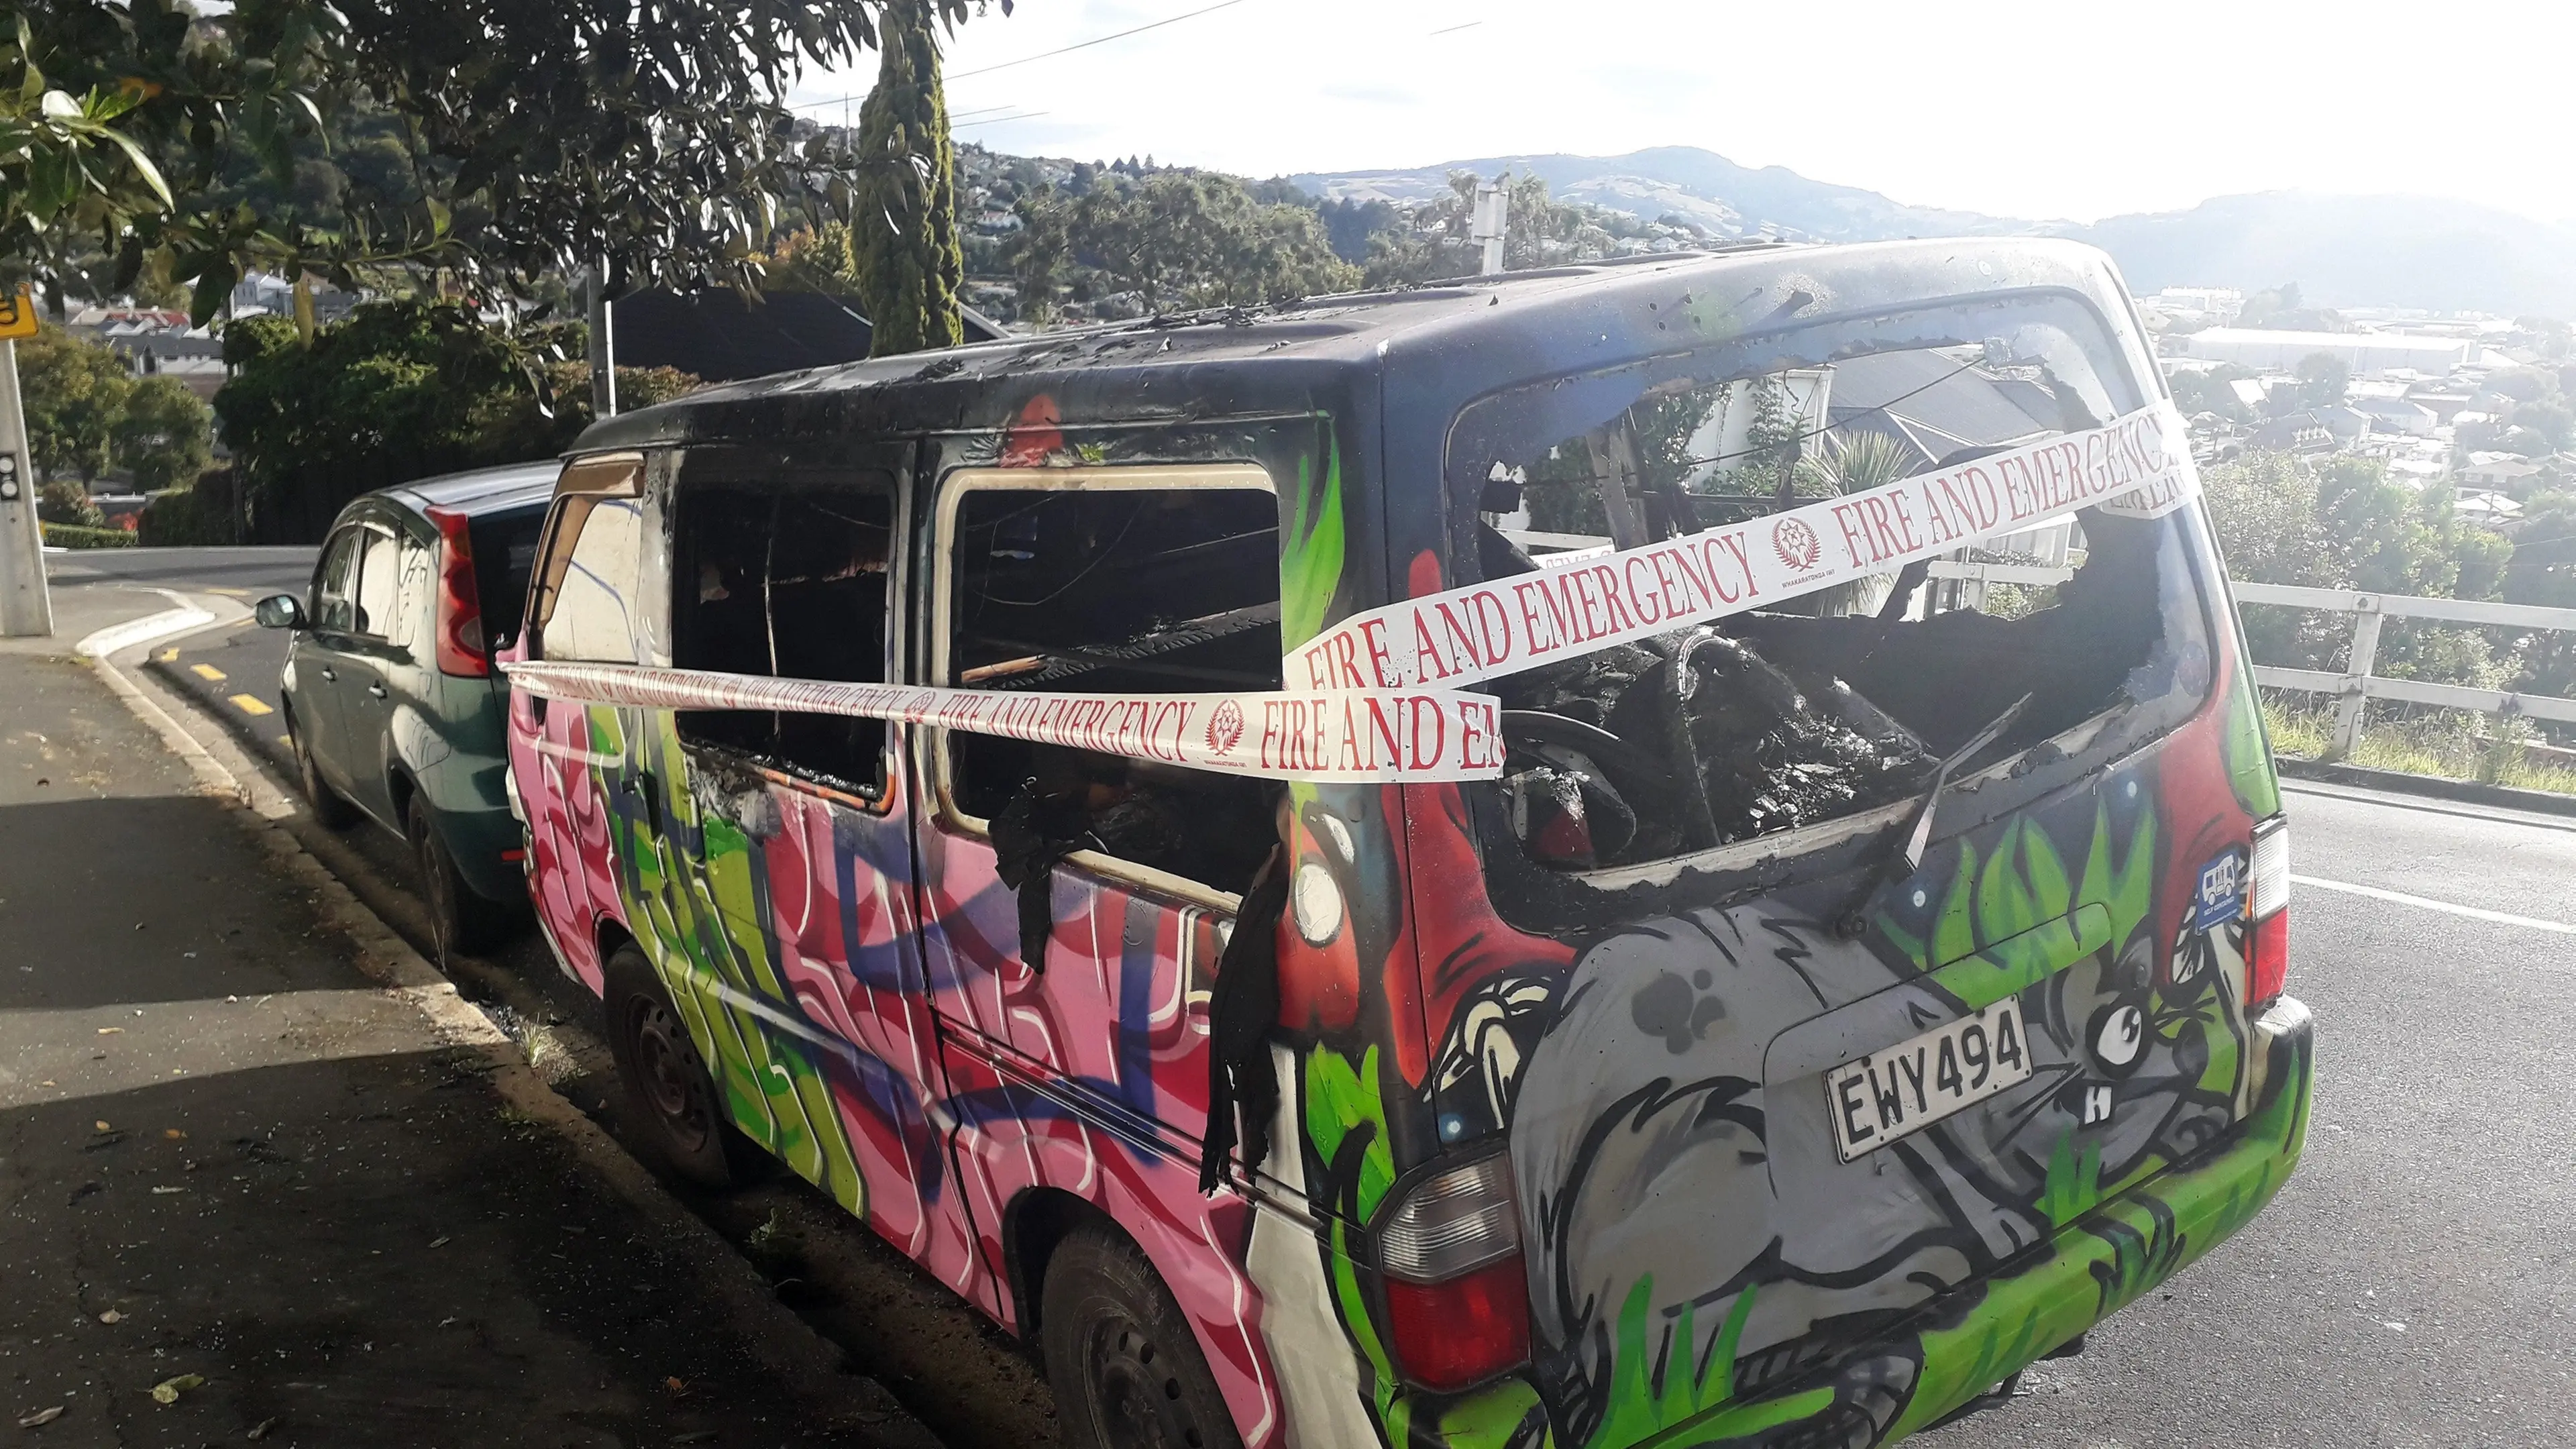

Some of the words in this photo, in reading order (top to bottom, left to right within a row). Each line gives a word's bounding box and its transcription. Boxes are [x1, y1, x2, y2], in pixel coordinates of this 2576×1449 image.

[1831, 488, 1924, 568] FIRE
[1922, 467, 1999, 544] AND
[1305, 617, 1403, 690] FIRE
[1414, 590, 1511, 685] AND
[1524, 531, 1760, 657] EMERGENCY
[938, 694, 992, 732] FIRE
[987, 696, 1040, 739] AND
[1037, 699, 1197, 761] EMERGENCY
[1261, 699, 1329, 771] FIRE
[1338, 695, 1444, 772] AND
[1838, 1010, 2022, 1145] EWY494
